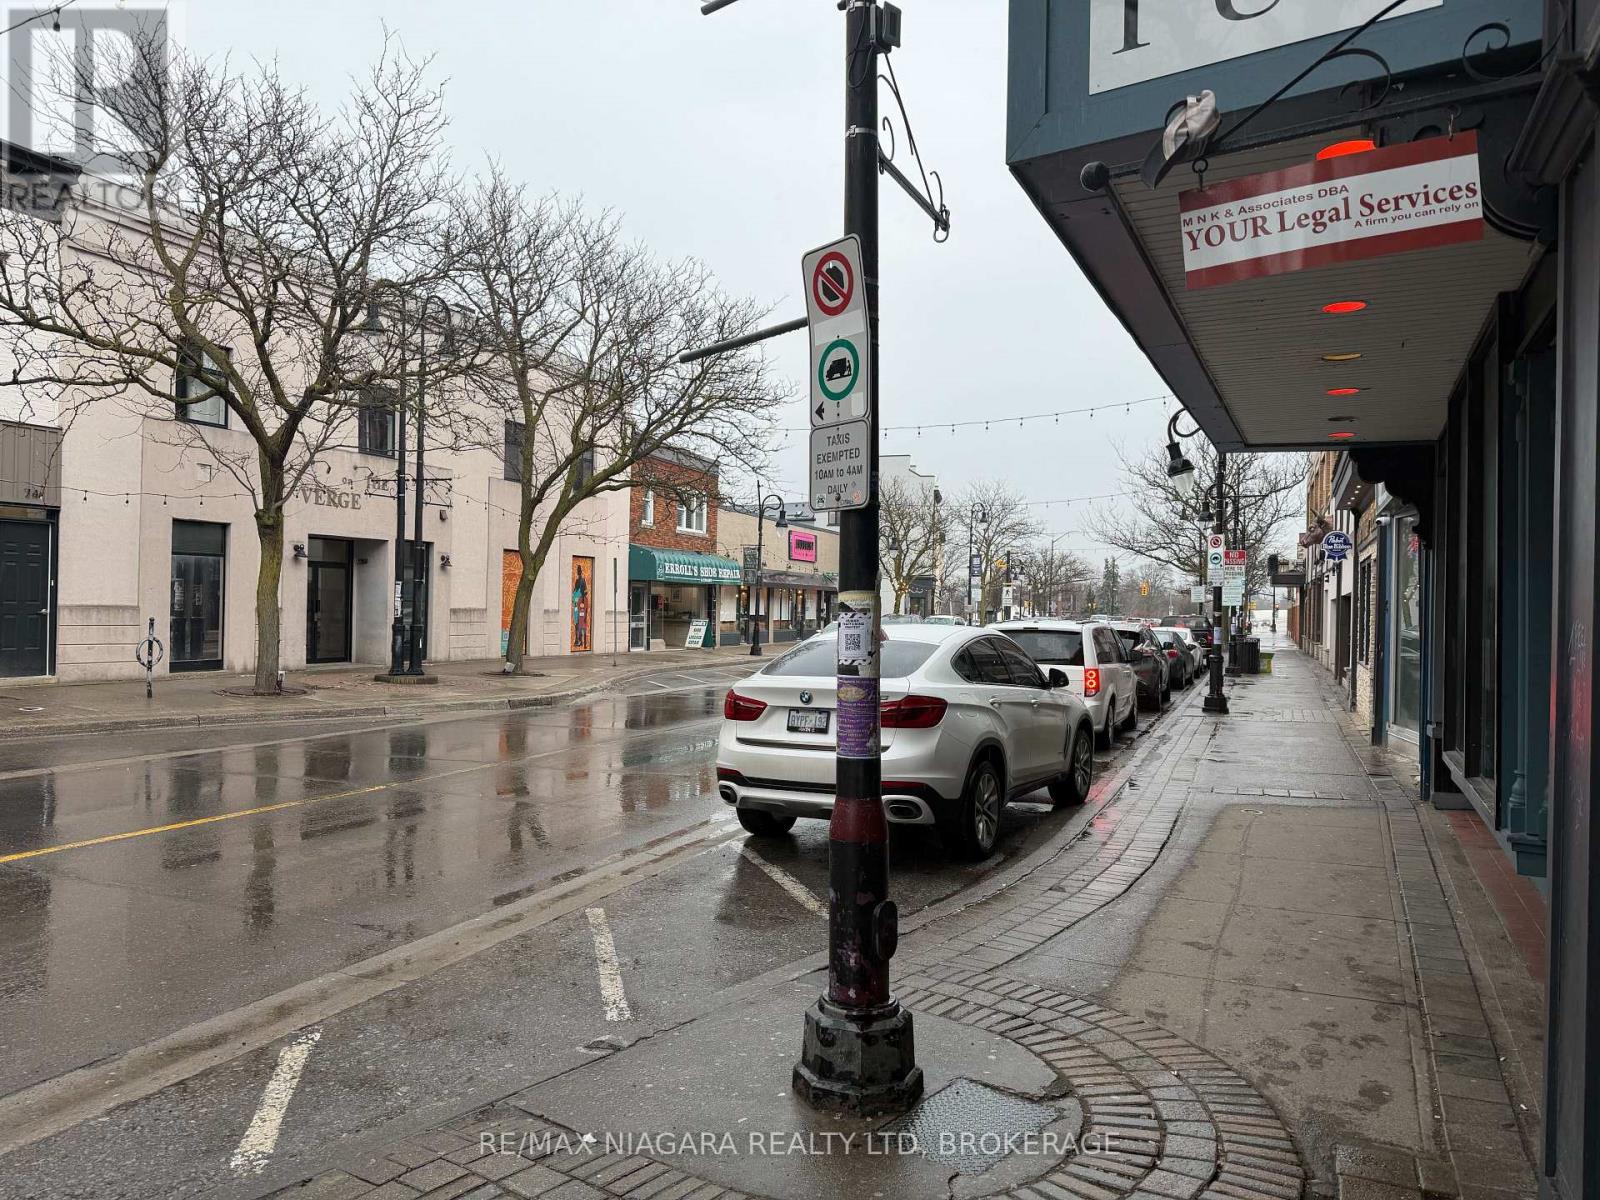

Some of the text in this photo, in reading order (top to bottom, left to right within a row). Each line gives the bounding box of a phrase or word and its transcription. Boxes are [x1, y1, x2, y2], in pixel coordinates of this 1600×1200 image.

[1183, 184, 1349, 228] M N K & Associates DBA
[1353, 201, 1479, 229] A firm you can rely on
[1184, 181, 1478, 252] YOUR Legal Services
[826, 432, 850, 447] TAXIS
[816, 447, 860, 465] EXEMPTED
[815, 464, 863, 481] 10AM to 4AM
[827, 483, 848, 495] DAILY
[301, 486, 362, 511] VERGE
[664, 563, 698, 577] ERROLL'S
[700, 566, 718, 578] SHOE
[718, 568, 741, 579] REPAIR
